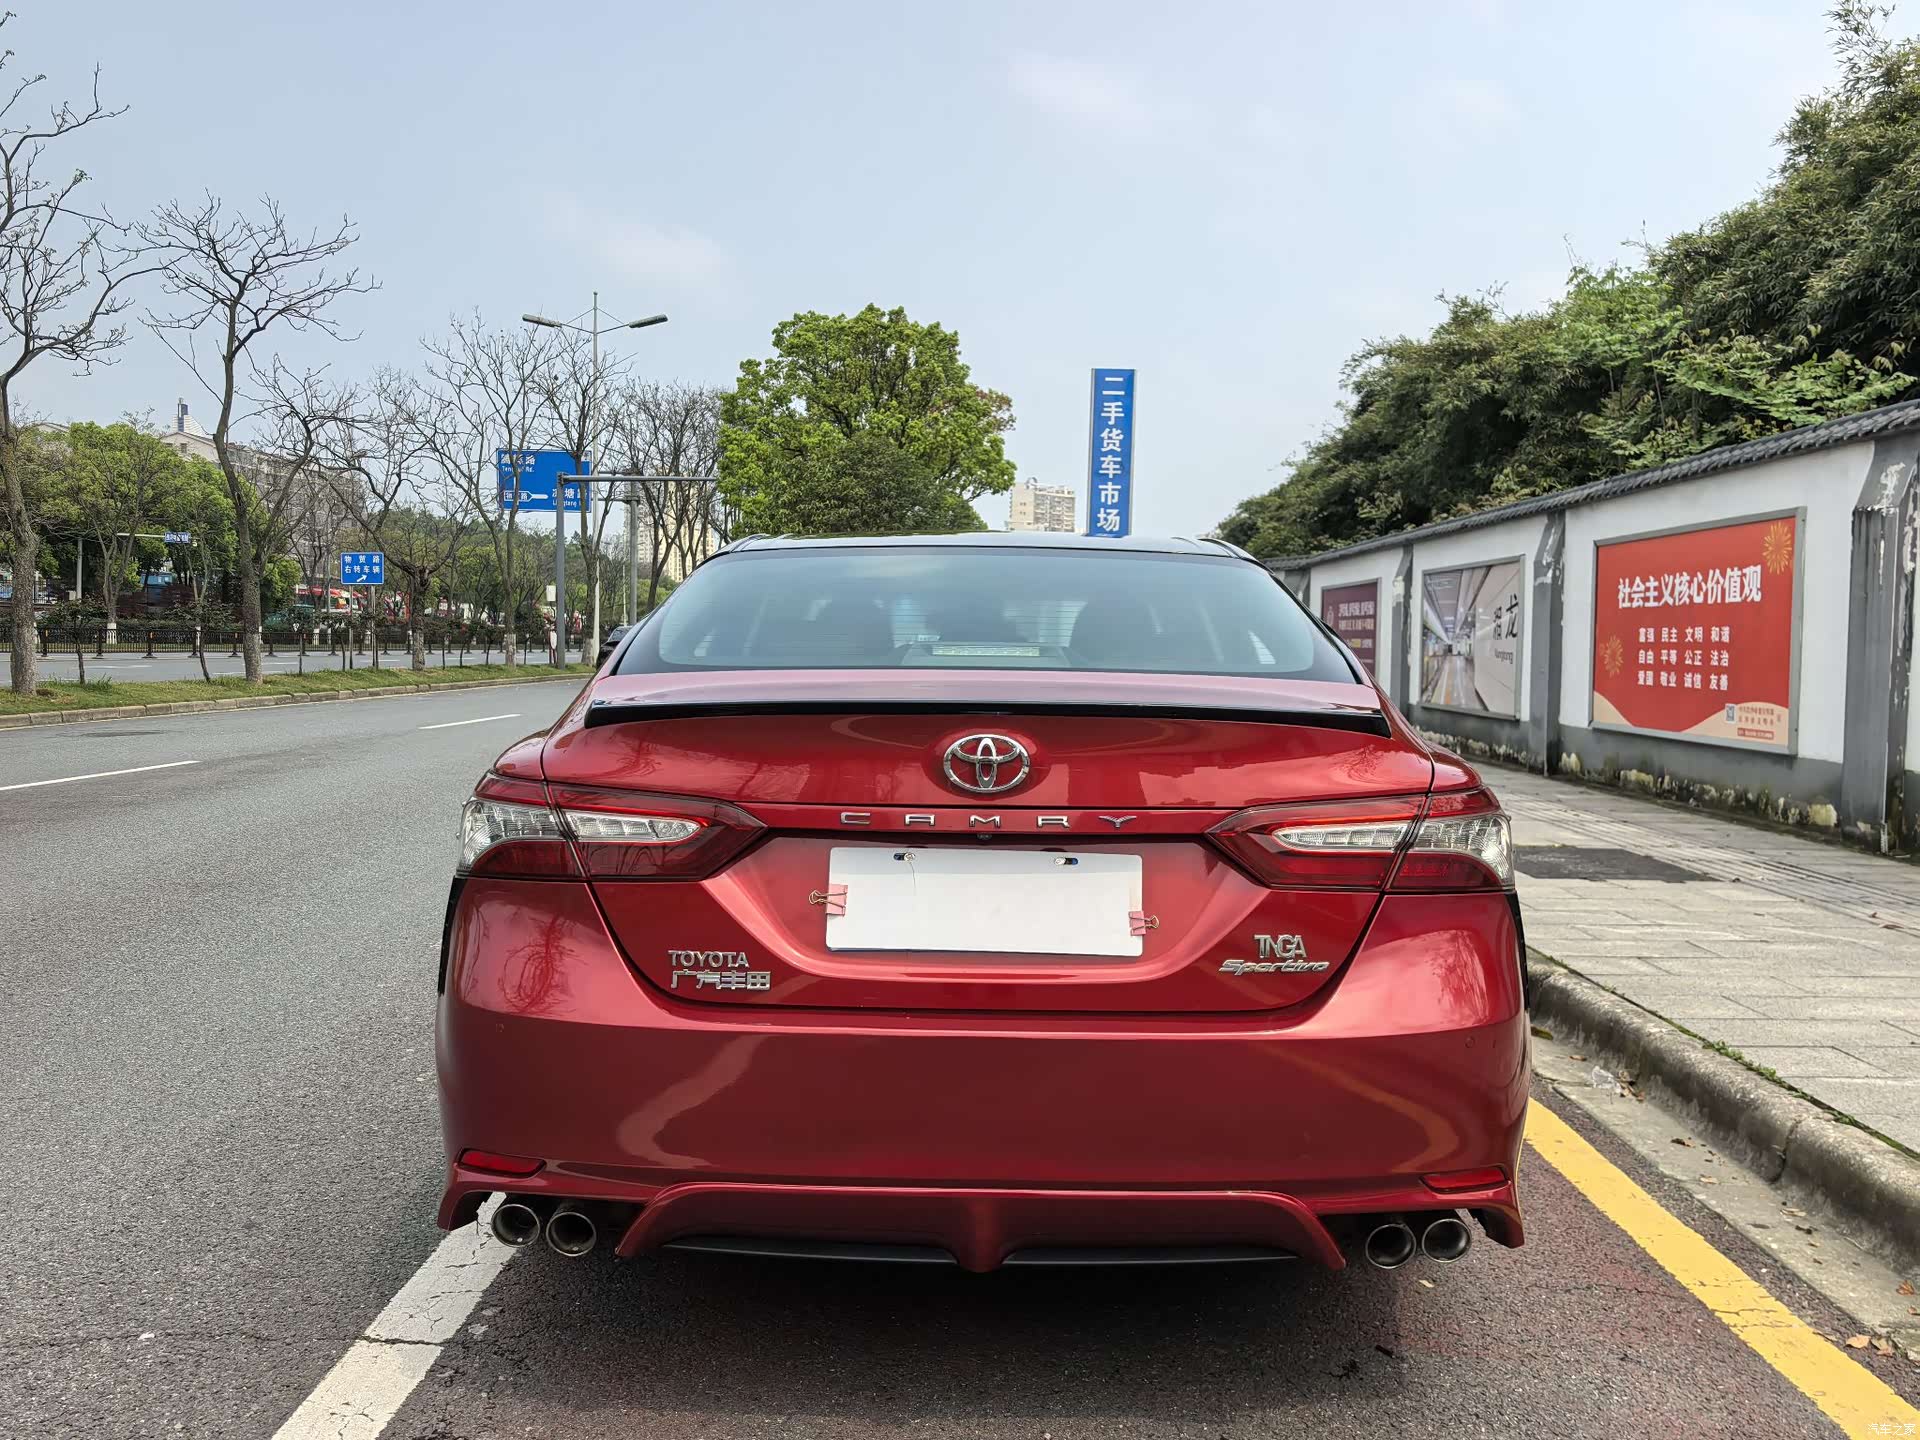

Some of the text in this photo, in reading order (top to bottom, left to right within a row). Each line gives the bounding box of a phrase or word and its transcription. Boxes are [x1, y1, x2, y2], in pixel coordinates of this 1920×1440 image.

[1096, 376, 1126, 532] 二手货车市场
[344, 565, 381, 575] 右转车辆
[1617, 564, 1762, 609] 社会主义核心价值观
[1638, 626, 1730, 644] 富强 民主 文明 和谐
[1638, 649, 1729, 667] 自由 平等 公正 法治
[1637, 670, 1728, 691] 爱国 敬业 诚信 友善
[840, 811, 1137, 828] CAMRY
[1254, 934, 1307, 958] TNGA
[668, 950, 750, 968] TOYOTA
[1218, 959, 1330, 976] Sportivo
[670, 969, 771, 990] 广汽丰田
